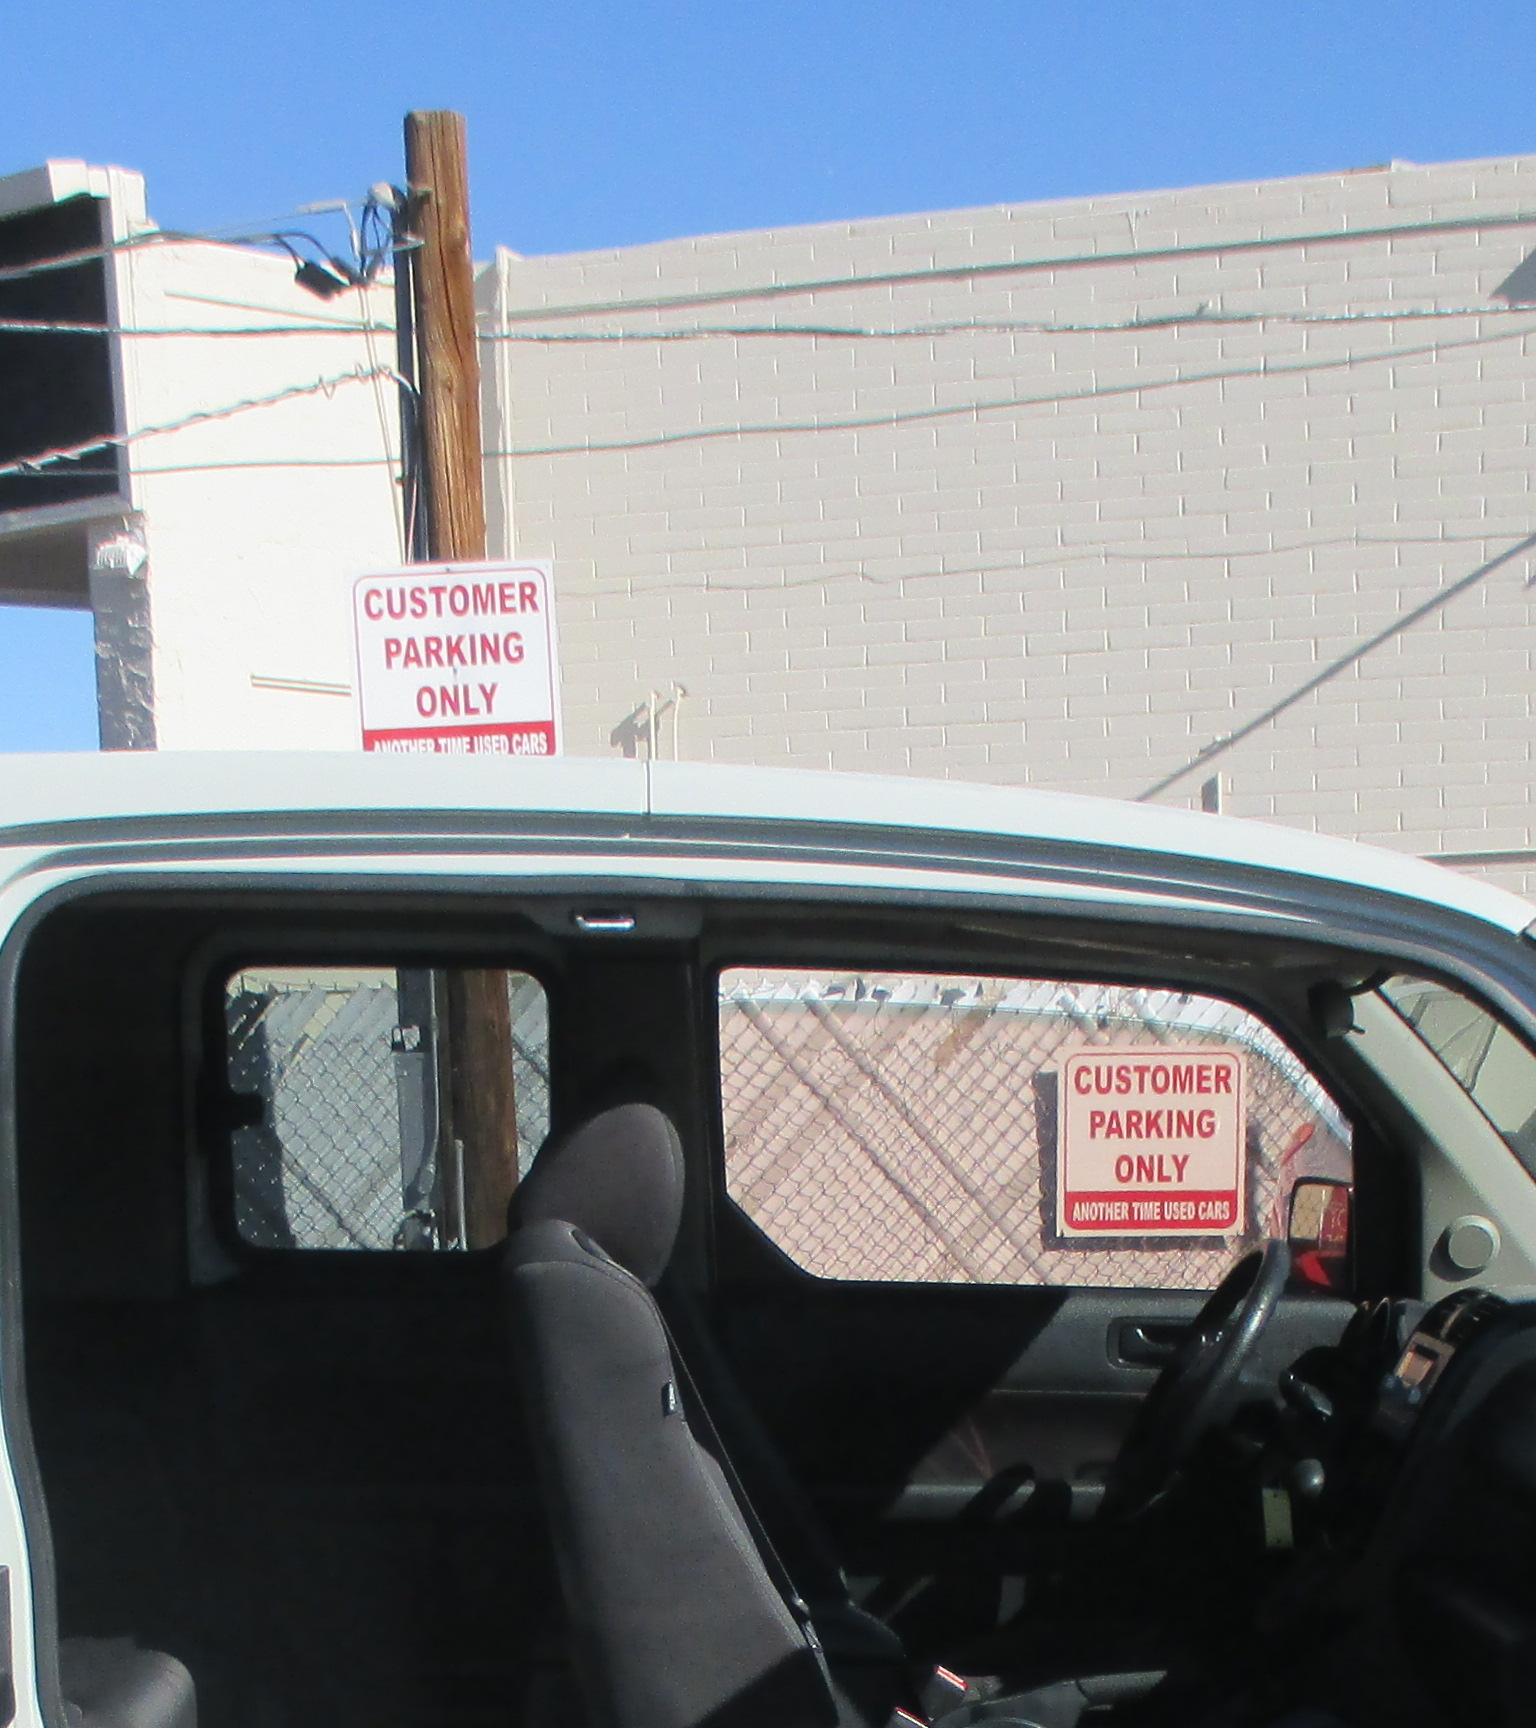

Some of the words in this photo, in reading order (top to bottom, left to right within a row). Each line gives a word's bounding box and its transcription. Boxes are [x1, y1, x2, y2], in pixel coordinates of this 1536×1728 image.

[364, 581, 540, 620] CUSTOMER
[384, 631, 525, 670] PARKING
[416, 682, 499, 718] ONLY
[437, 735, 471, 755] TIME
[474, 733, 510, 755] USED
[513, 731, 548, 755] CARS
[1074, 1064, 1233, 1095] CUSTOMER
[1089, 1109, 1216, 1139] PARKING
[1115, 1154, 1191, 1184] ONLY
[1072, 1201, 1129, 1221] ANOTHER
[1131, 1201, 1162, 1221] TIME
[1164, 1200, 1196, 1221] USED
[1198, 1200, 1231, 1220] CARS
